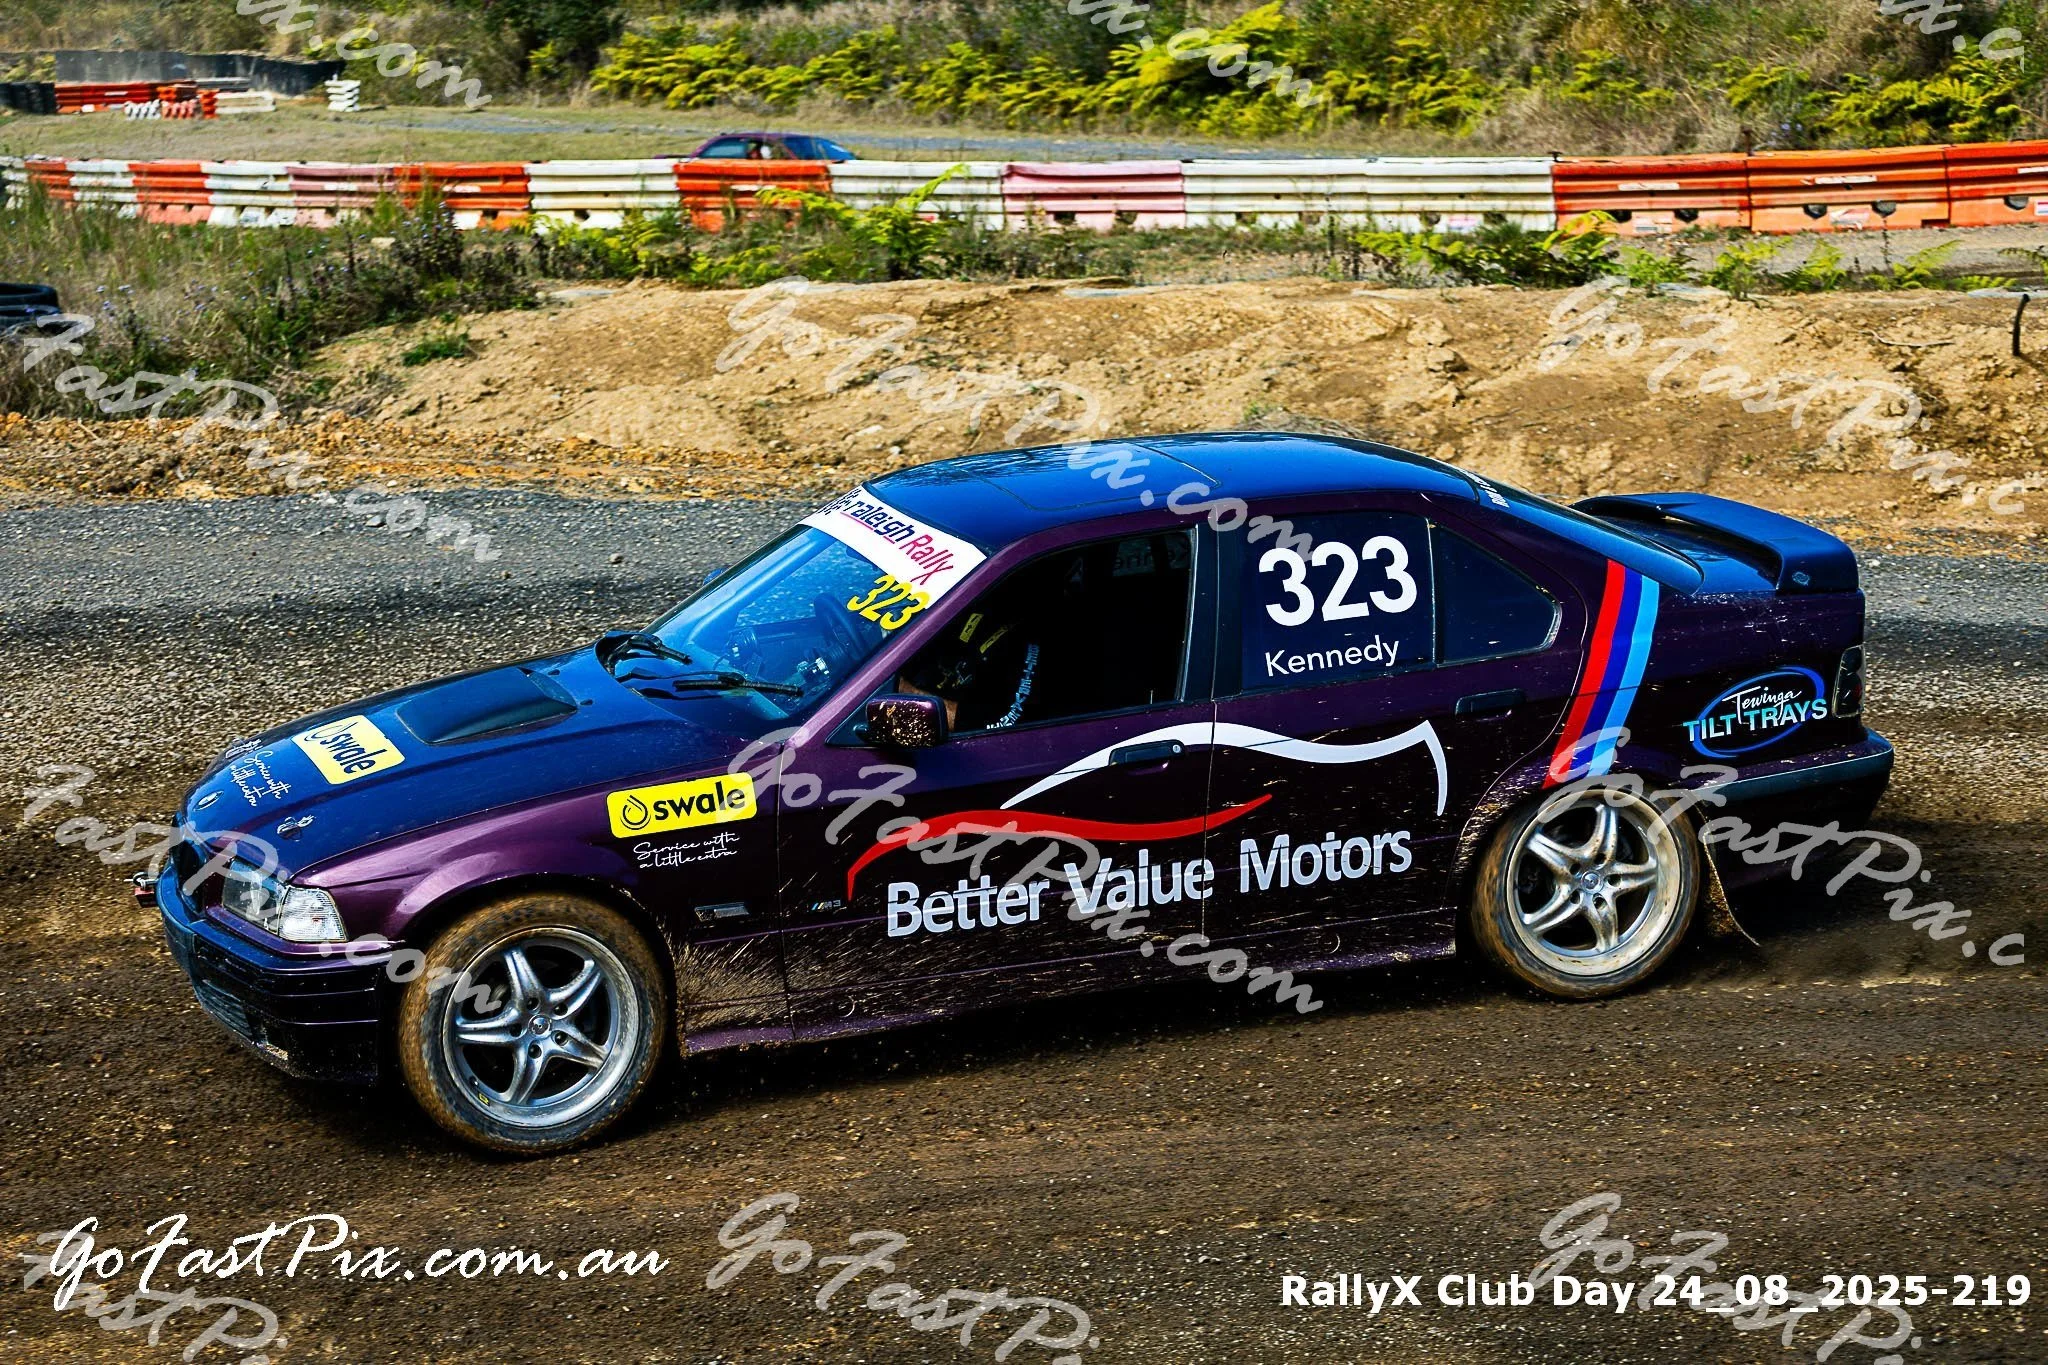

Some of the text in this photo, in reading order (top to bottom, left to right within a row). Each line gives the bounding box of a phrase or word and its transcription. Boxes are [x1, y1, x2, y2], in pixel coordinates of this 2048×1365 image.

[847, 573, 930, 630] 323
[1259, 535, 1418, 626] 323
[1264, 634, 1400, 677] Kennedy
[1682, 698, 1828, 742] TILT TRAYS
[1722, 686, 1802, 725] Tewinga
[319, 732, 388, 774] swale
[653, 781, 746, 821] swale
[633, 831, 741, 861] Service with
[654, 851, 698, 867] little
[887, 831, 1413, 937] Better Value Motors
